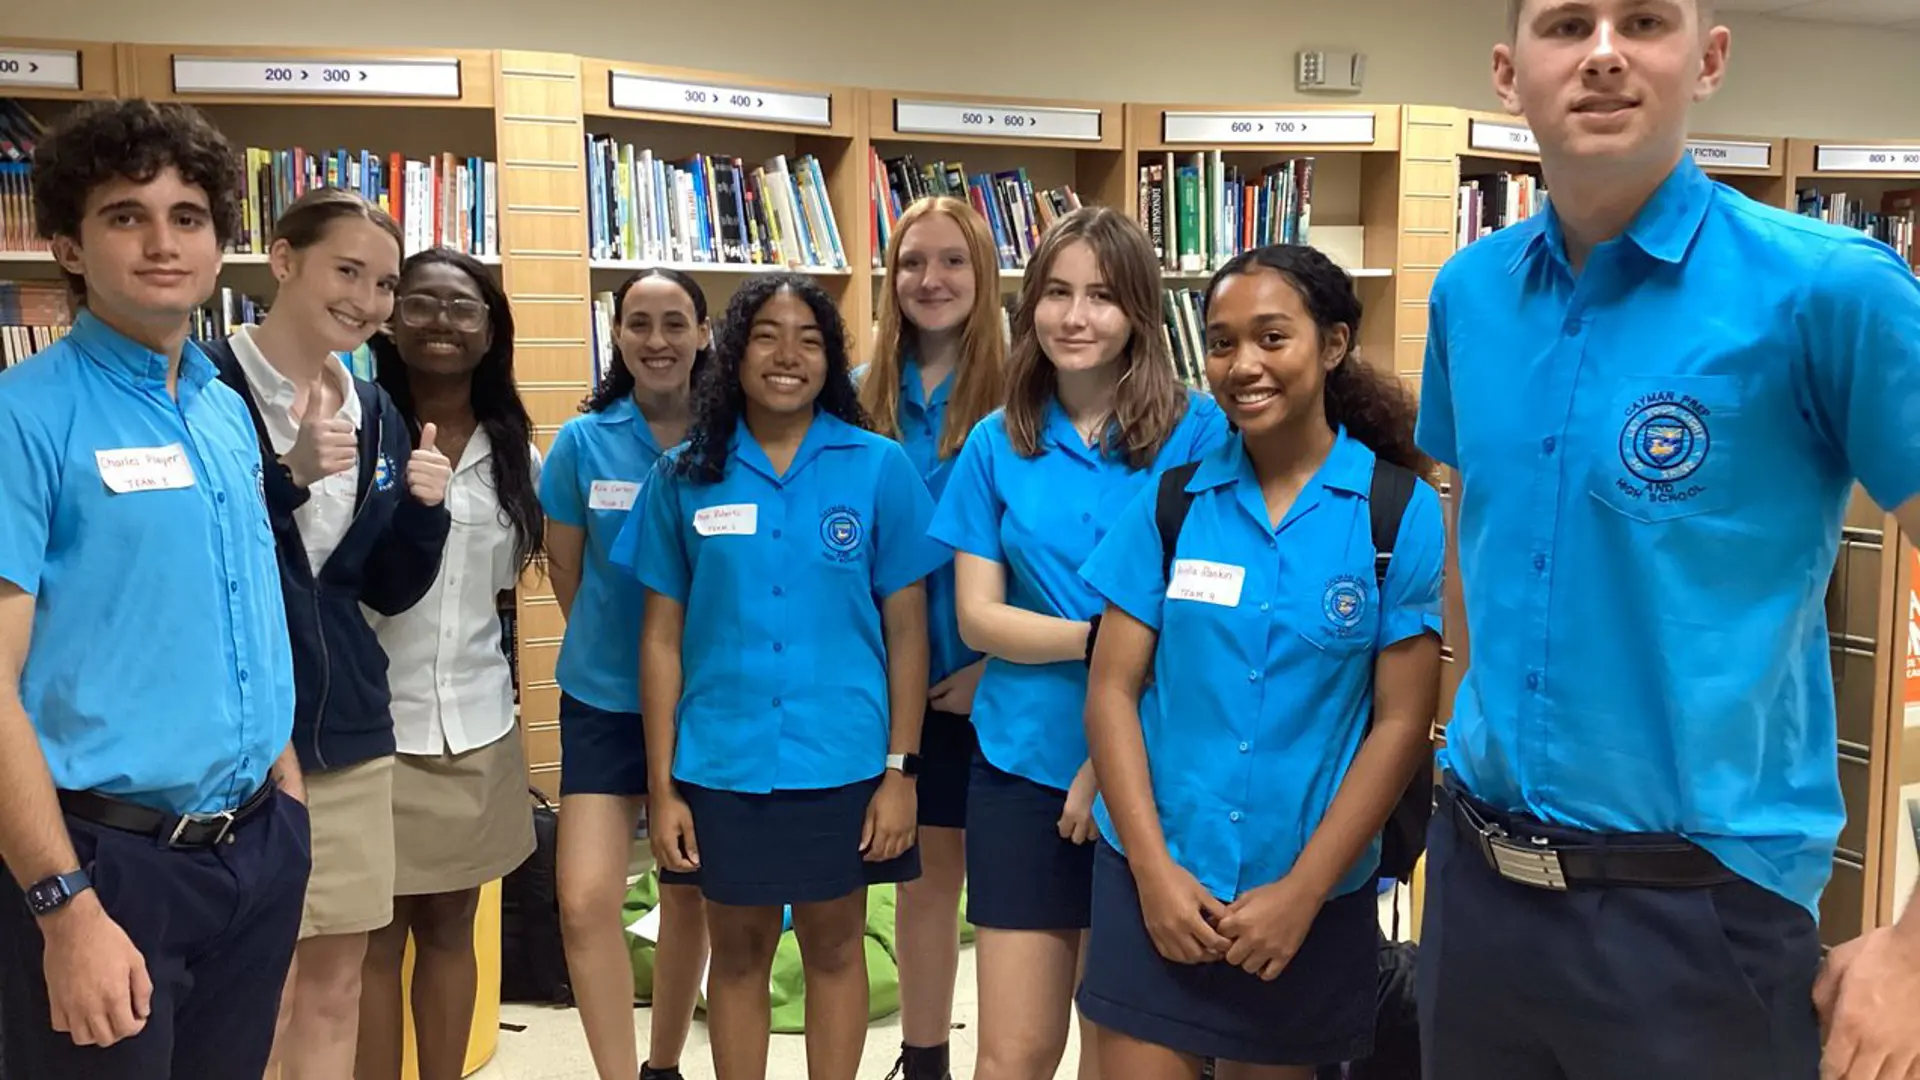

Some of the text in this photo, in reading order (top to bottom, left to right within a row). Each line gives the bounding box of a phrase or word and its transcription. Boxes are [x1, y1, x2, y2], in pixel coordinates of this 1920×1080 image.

[265, 68, 350, 82] 200 300
[685, 90, 751, 107] 300 400
[962, 113, 1024, 126] 500 600
[1231, 121, 1295, 132] 600 700
[1695, 148, 1727, 158] FICTION
[1869, 154, 1919, 163] 800 900
[1624, 391, 1675, 416] CAYMAN
[1680, 395, 1711, 416] PREP
[100, 456, 140, 469] Charles
[124, 479, 156, 489] TEAM
[1644, 482, 1674, 493] AND
[1649, 485, 1707, 502] SCHOOL
